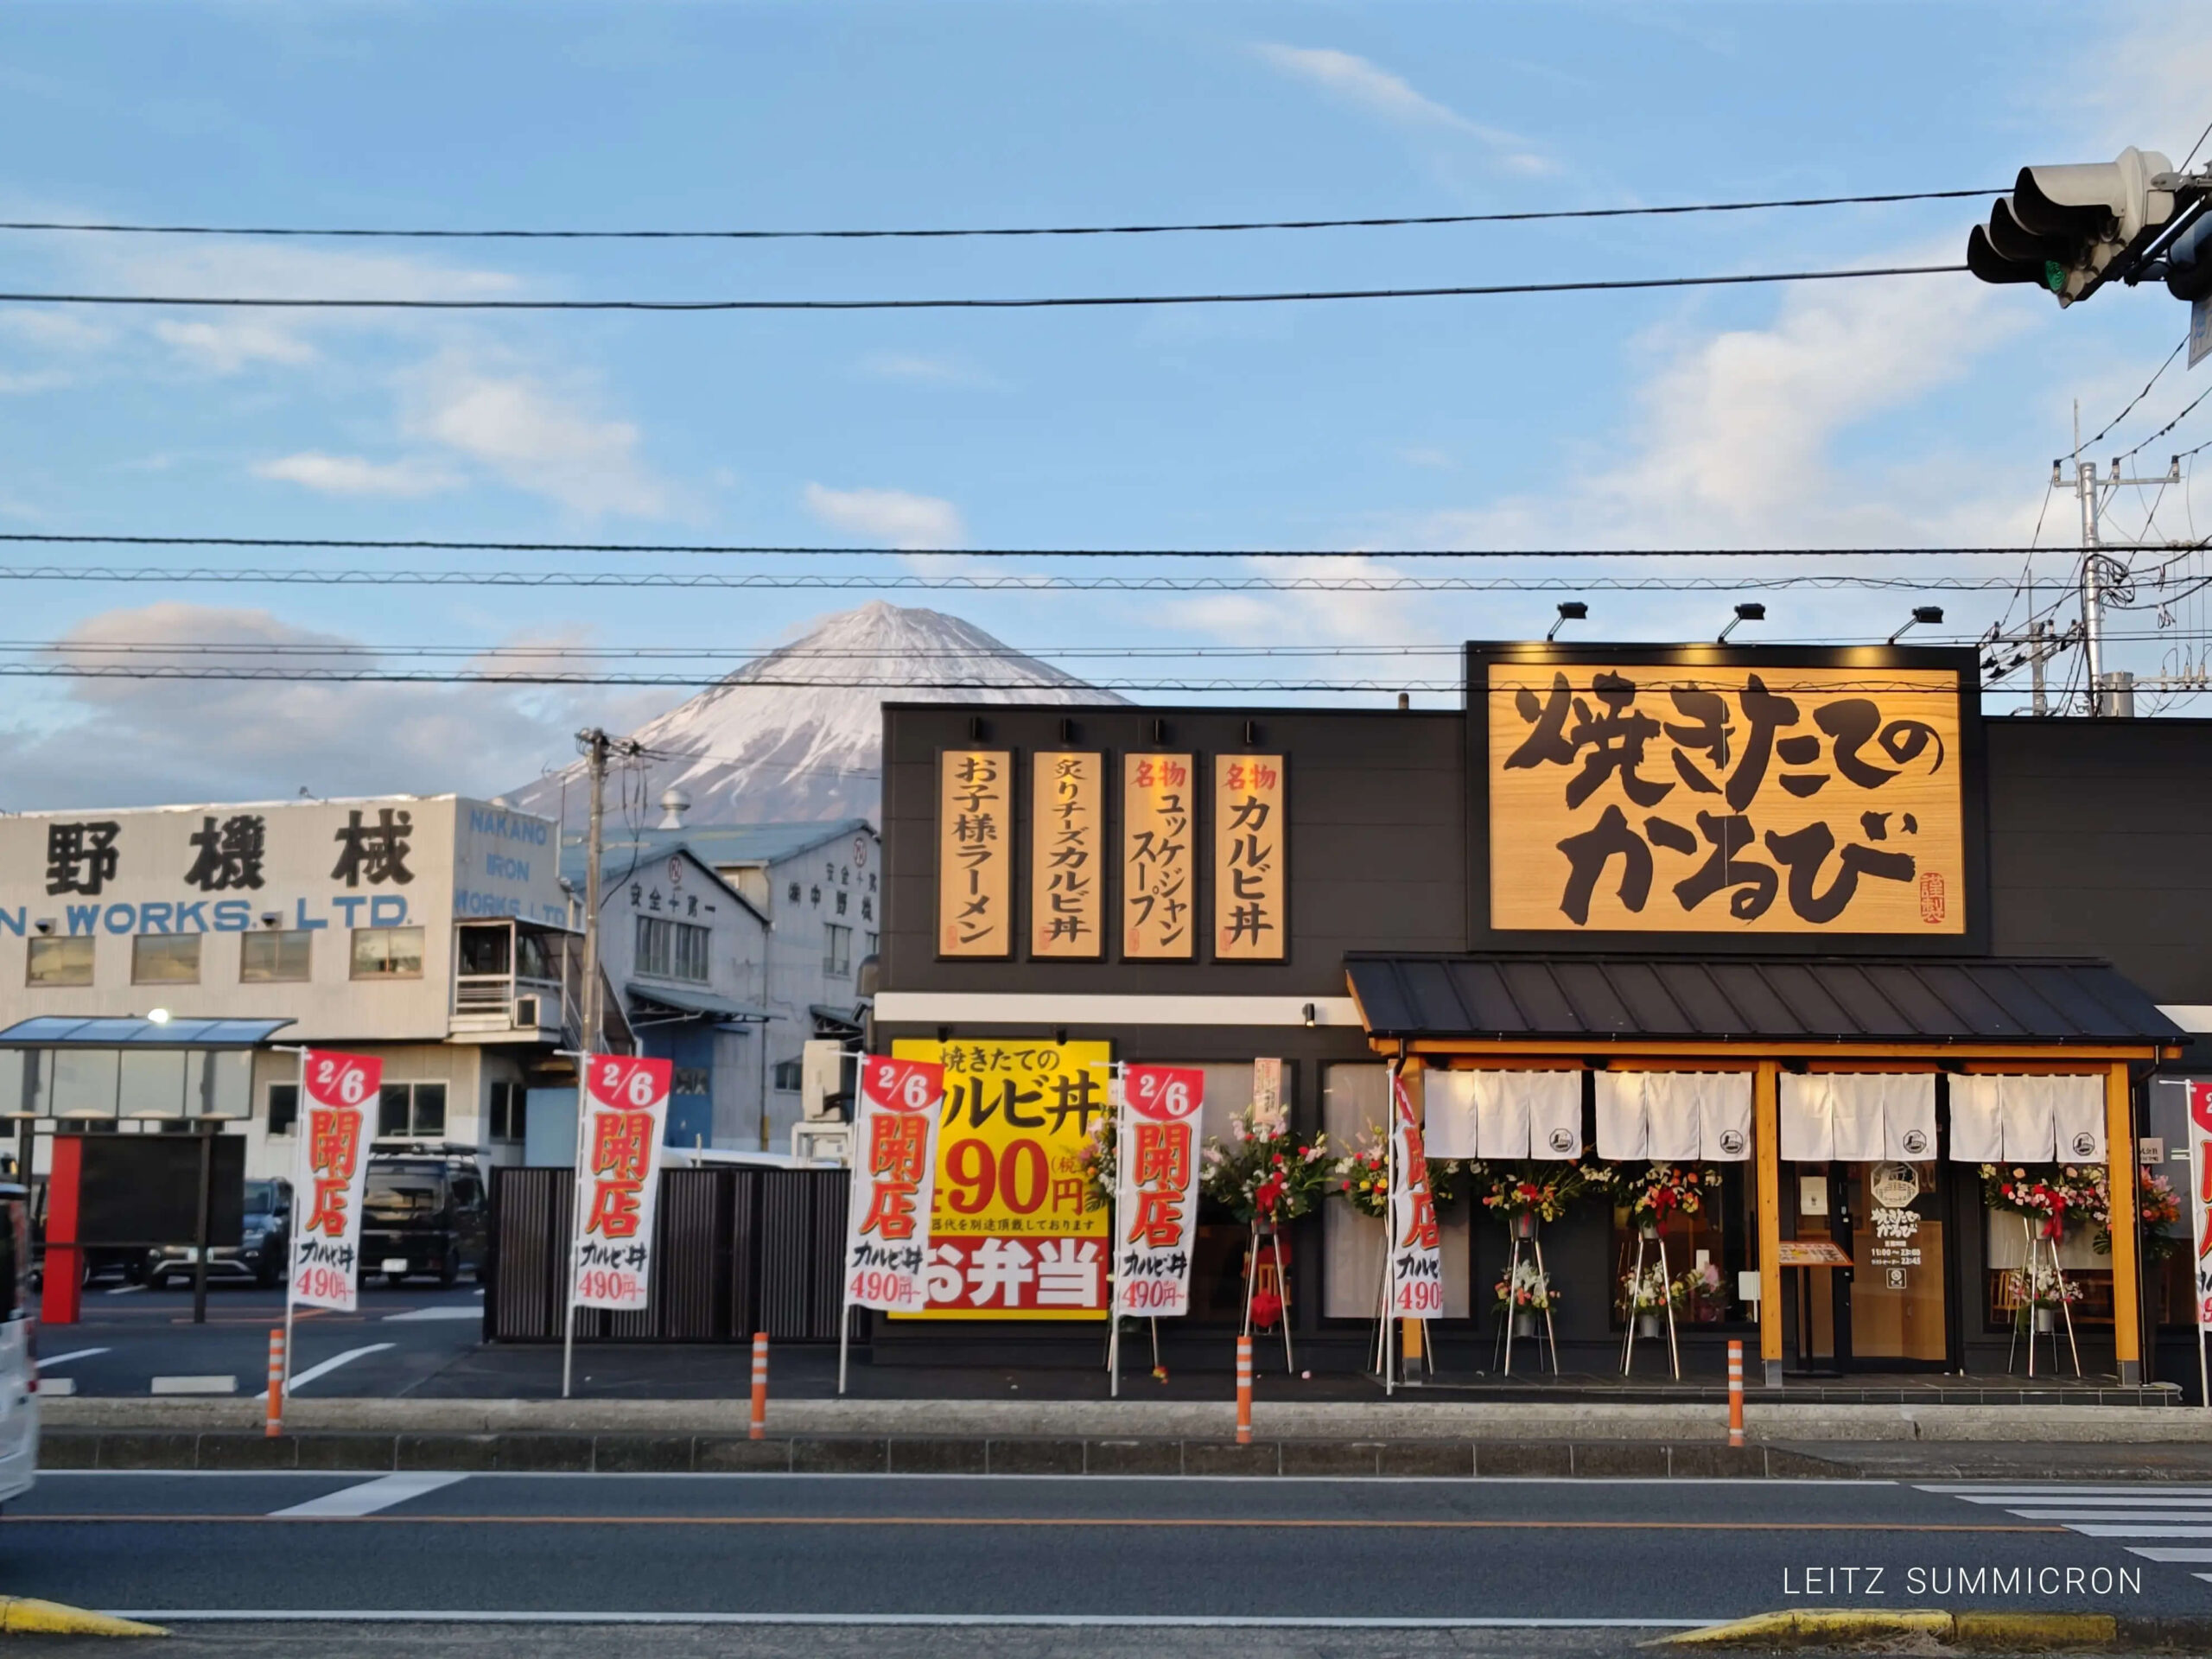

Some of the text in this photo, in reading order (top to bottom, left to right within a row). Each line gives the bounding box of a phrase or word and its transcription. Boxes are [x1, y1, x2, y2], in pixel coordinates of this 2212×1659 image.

[1132, 760, 1186, 788] 名物
[1221, 763, 1277, 791] 名物
[1503, 670, 1944, 814] 焼きたての
[46, 808, 415, 896] 野機械
[469, 805, 548, 846] NAKANO
[486, 852, 531, 882] IRON
[950, 757, 1000, 944] お子様ラーメン
[1044, 759, 1092, 943] 炙りチーズカルビ丼
[1155, 794, 1187, 947] ユッケジャン
[1224, 796, 1274, 947] カルビ丼
[1556, 804, 1918, 926] かるび
[1128, 830, 1160, 927] スープ
[316, 1059, 365, 1103] 2/6
[601, 1063, 654, 1106] 2/6
[878, 1065, 929, 1108] 2/6
[941, 1069, 1101, 1137] ルビ丼
[1139, 1072, 1190, 1116] 2/6
[305, 1108, 364, 1237] 開店
[585, 1109, 655, 1239] 開店
[859, 1111, 930, 1242] 開店
[1127, 1122, 1192, 1249] 開店
